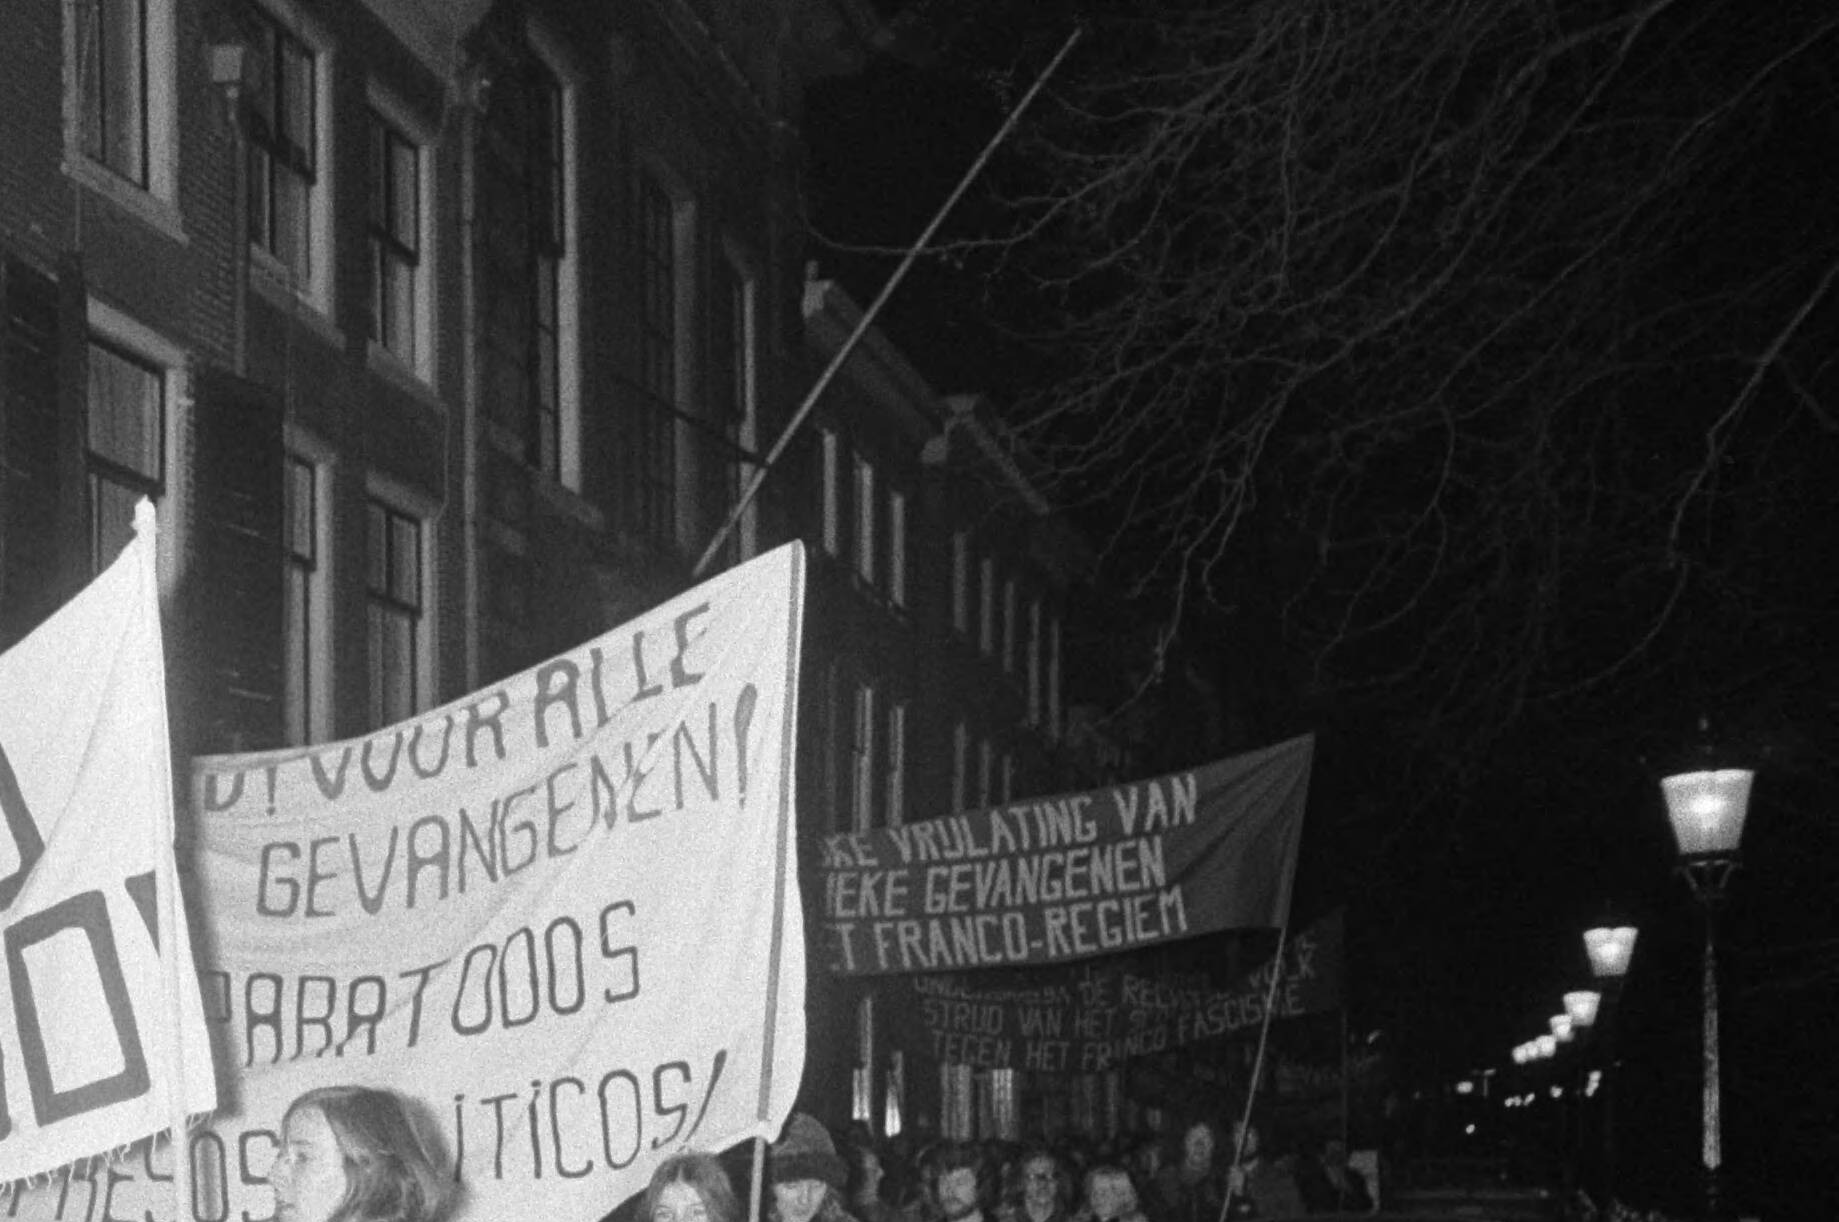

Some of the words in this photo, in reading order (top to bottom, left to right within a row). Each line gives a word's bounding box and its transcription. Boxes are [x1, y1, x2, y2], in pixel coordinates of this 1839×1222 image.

[256, 683, 759, 919] GEVANGENEN!
[1113, 774, 1198, 837] VAN
[924, 835, 1167, 913] GEVANGENEN
[874, 884, 1189, 972] FRANCO-REGIEM
[399, 899, 641, 1049] TODOS
